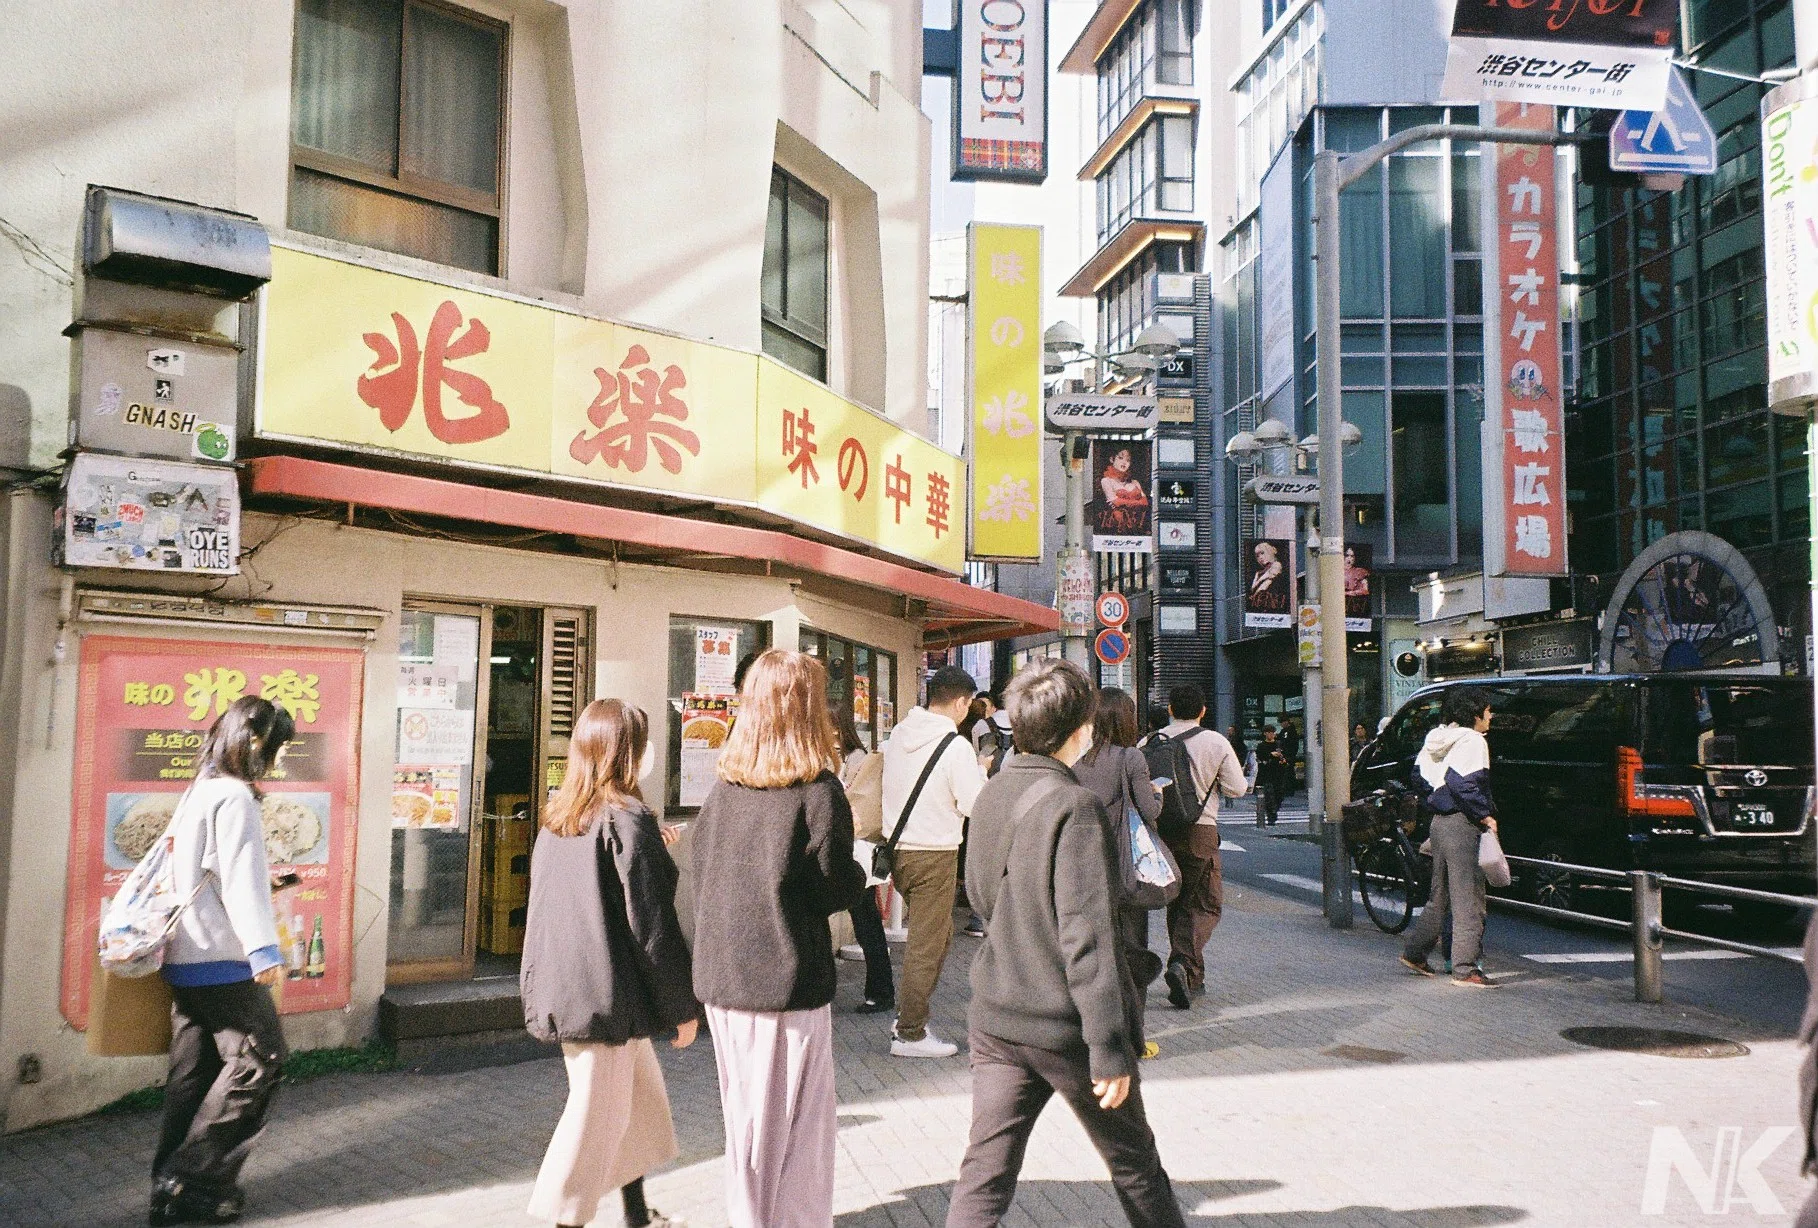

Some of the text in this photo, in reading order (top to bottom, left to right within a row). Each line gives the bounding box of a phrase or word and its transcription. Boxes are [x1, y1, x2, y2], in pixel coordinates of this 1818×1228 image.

[1477, 54, 1636, 84] 渋谷センター街
[1507, 176, 1547, 352] カラオケ
[1167, 360, 1185, 372] DX
[356, 300, 701, 476] 兆楽
[126, 404, 196, 433] GNASH
[1053, 402, 1154, 419] 渋谷センター街
[781, 406, 951, 541] 味の中華
[1260, 480, 1320, 494] 渋谷センタ
[1510, 408, 1552, 559] 歌広場
[191, 531, 229, 550] OYE
[191, 550, 229, 568] RUNS
[1104, 601, 1122, 617] 30
[1518, 645, 1577, 663] COLLECTION
